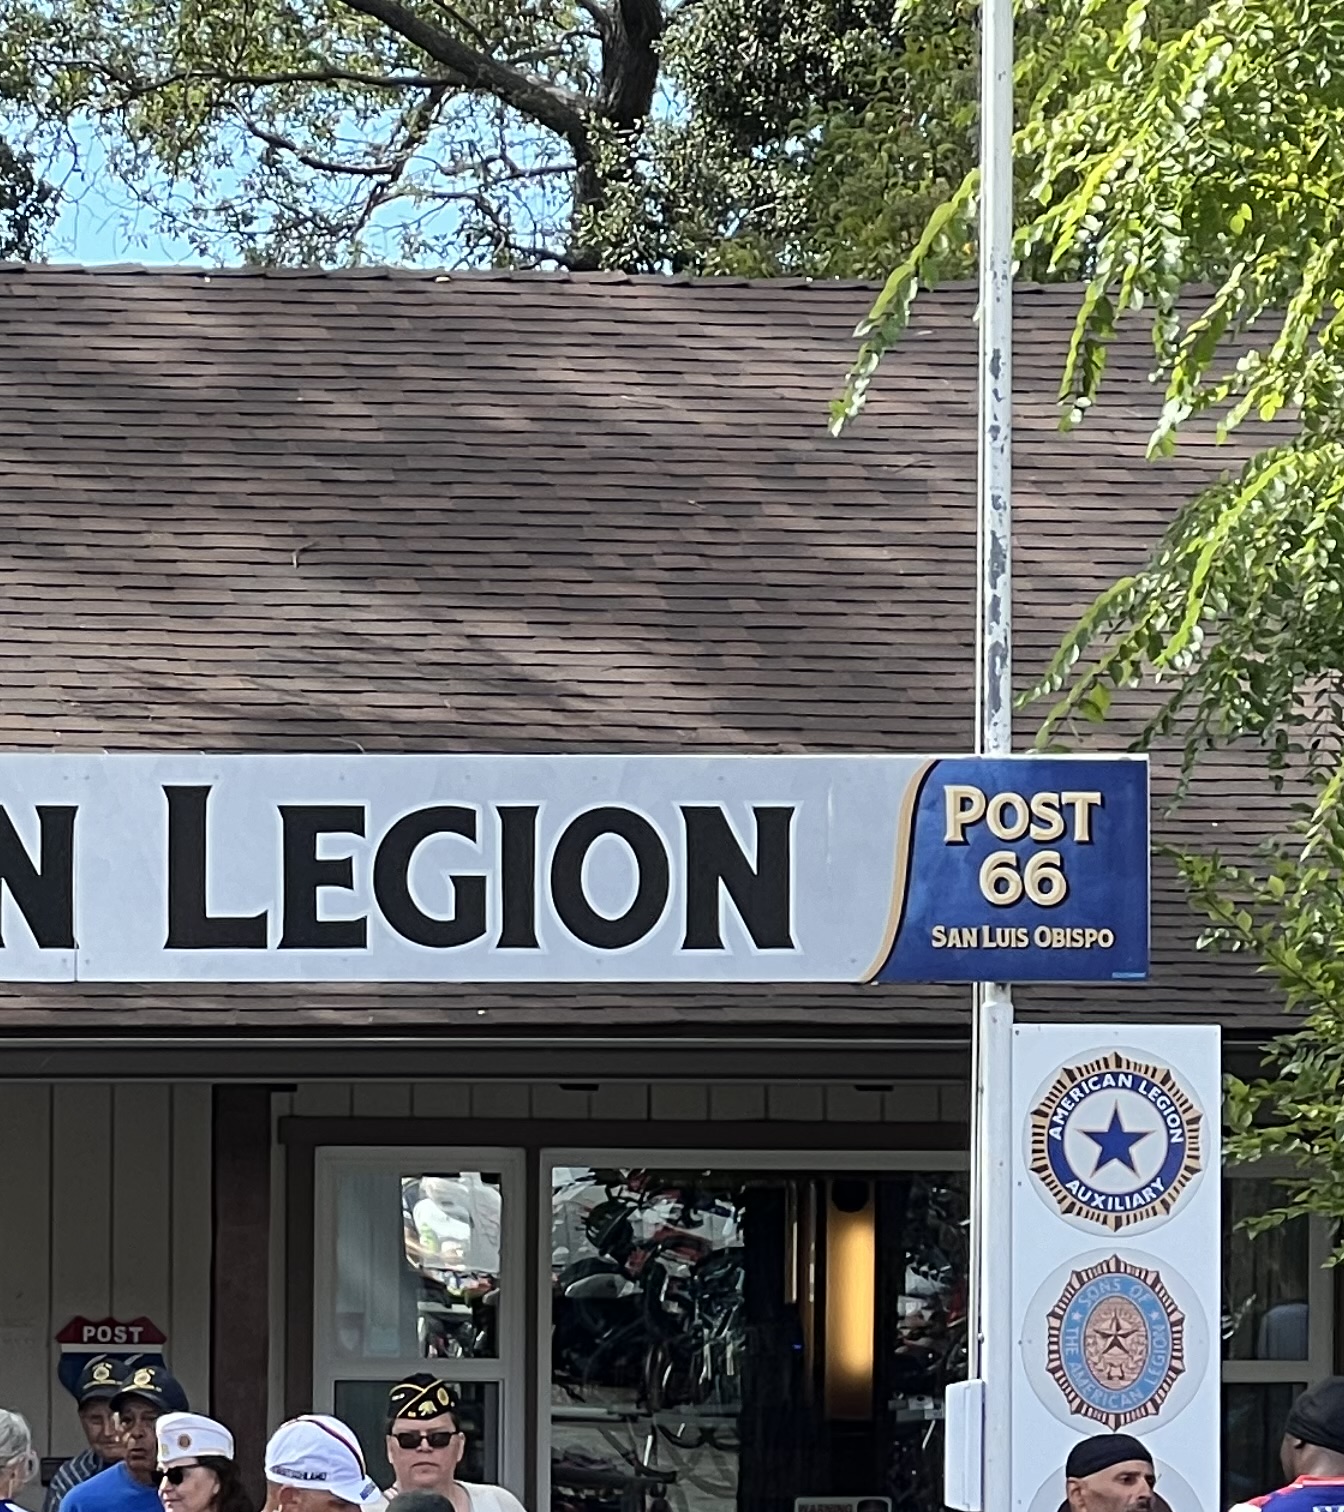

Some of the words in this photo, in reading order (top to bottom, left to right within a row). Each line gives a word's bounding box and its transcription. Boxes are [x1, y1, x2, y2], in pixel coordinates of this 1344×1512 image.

[943, 785, 1102, 843] POST
[161, 783, 796, 950] LEGION
[979, 851, 1068, 906] 66
[931, 925, 979, 949] SAN
[982, 925, 1030, 949] LUIS
[1033, 925, 1115, 949] OBISPO
[1048, 1073, 1133, 1141] AMERICAN
[1138, 1079, 1184, 1144] LEGION
[1065, 1176, 1166, 1211] AUXILIARY
[1078, 1278, 1121, 1306] SONS
[1129, 1283, 1155, 1303] OF
[82, 1325, 145, 1343] POST
[1065, 1327, 1080, 1356] THE
[1143, 1323, 1168, 1387] LEGION
[1067, 1360, 1145, 1409] AMERICAN
